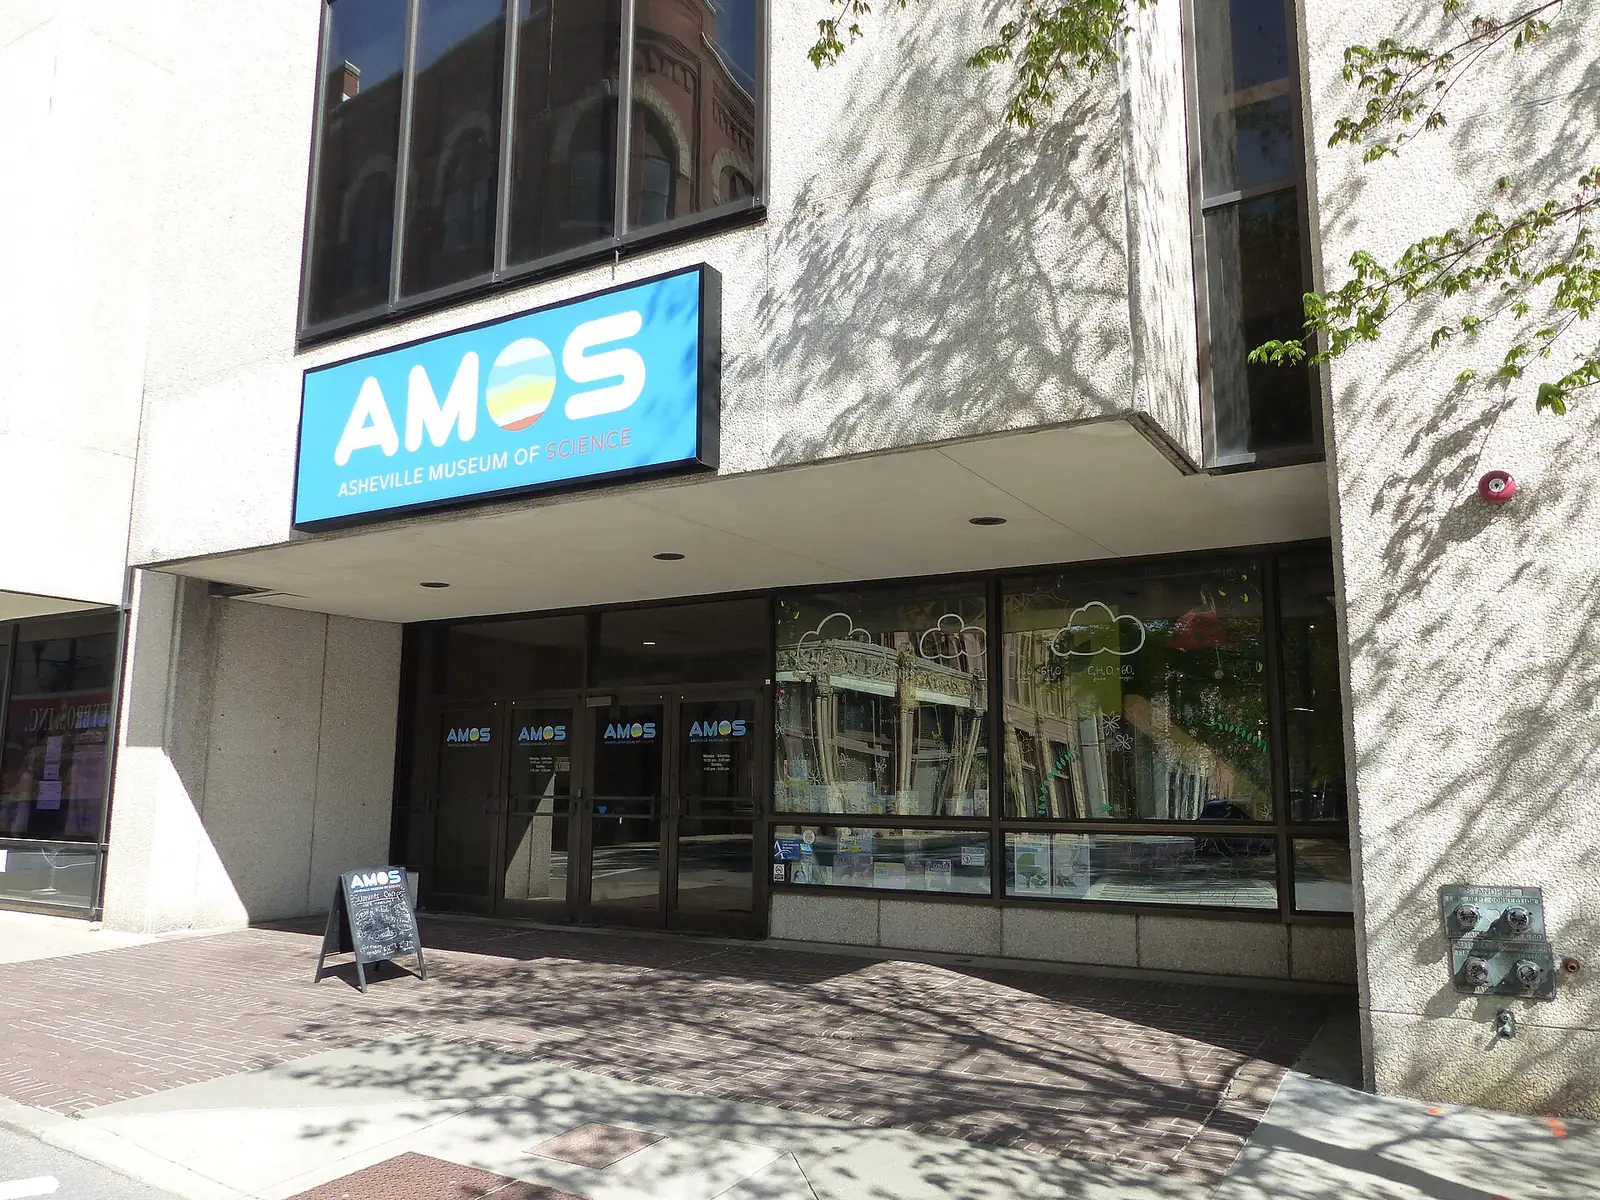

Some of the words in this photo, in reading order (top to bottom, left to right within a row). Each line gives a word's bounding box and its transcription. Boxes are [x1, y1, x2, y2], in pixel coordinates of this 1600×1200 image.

[334, 310, 646, 467] AMOS
[338, 467, 423, 497] ASHEVILLE
[429, 451, 508, 481] MUSEUM
[514, 445, 540, 467] OF
[546, 428, 632, 461] SCIENCE
[447, 727, 491, 742] AMOS
[518, 725, 566, 741] AMOS
[604, 722, 656, 739] AMOS
[689, 720, 746, 737] AMOS
[351, 869, 402, 889] AMOS
[1466, 888, 1514, 896] STANDPIPE
